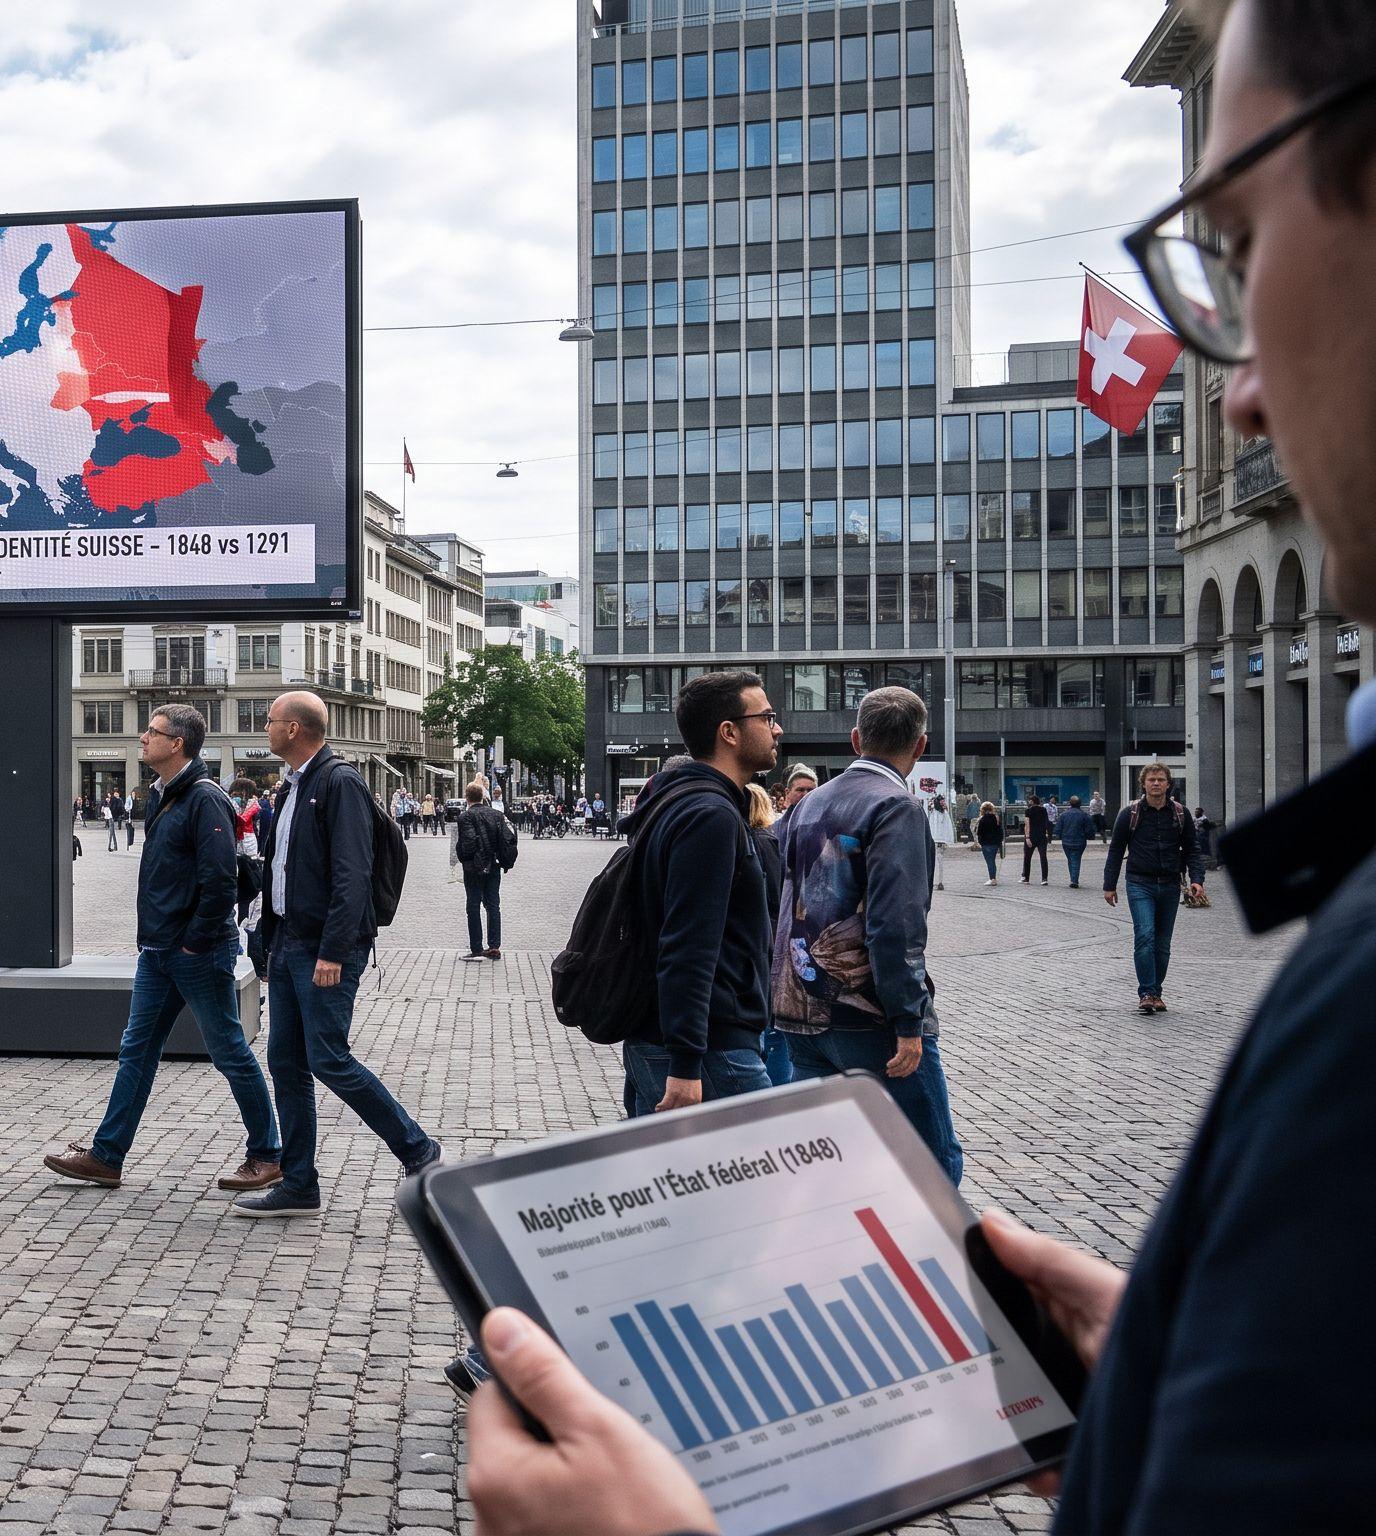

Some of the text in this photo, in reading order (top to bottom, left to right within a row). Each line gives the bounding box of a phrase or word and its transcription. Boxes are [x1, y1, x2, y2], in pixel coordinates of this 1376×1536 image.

[77, 535, 144, 557] SUISSE
[167, 533, 212, 555] 1848
[218, 538, 239, 554] vs
[246, 531, 289, 554] 1291
[517, 1136, 843, 1233] Majorité pour l'État fédéral (1848)
